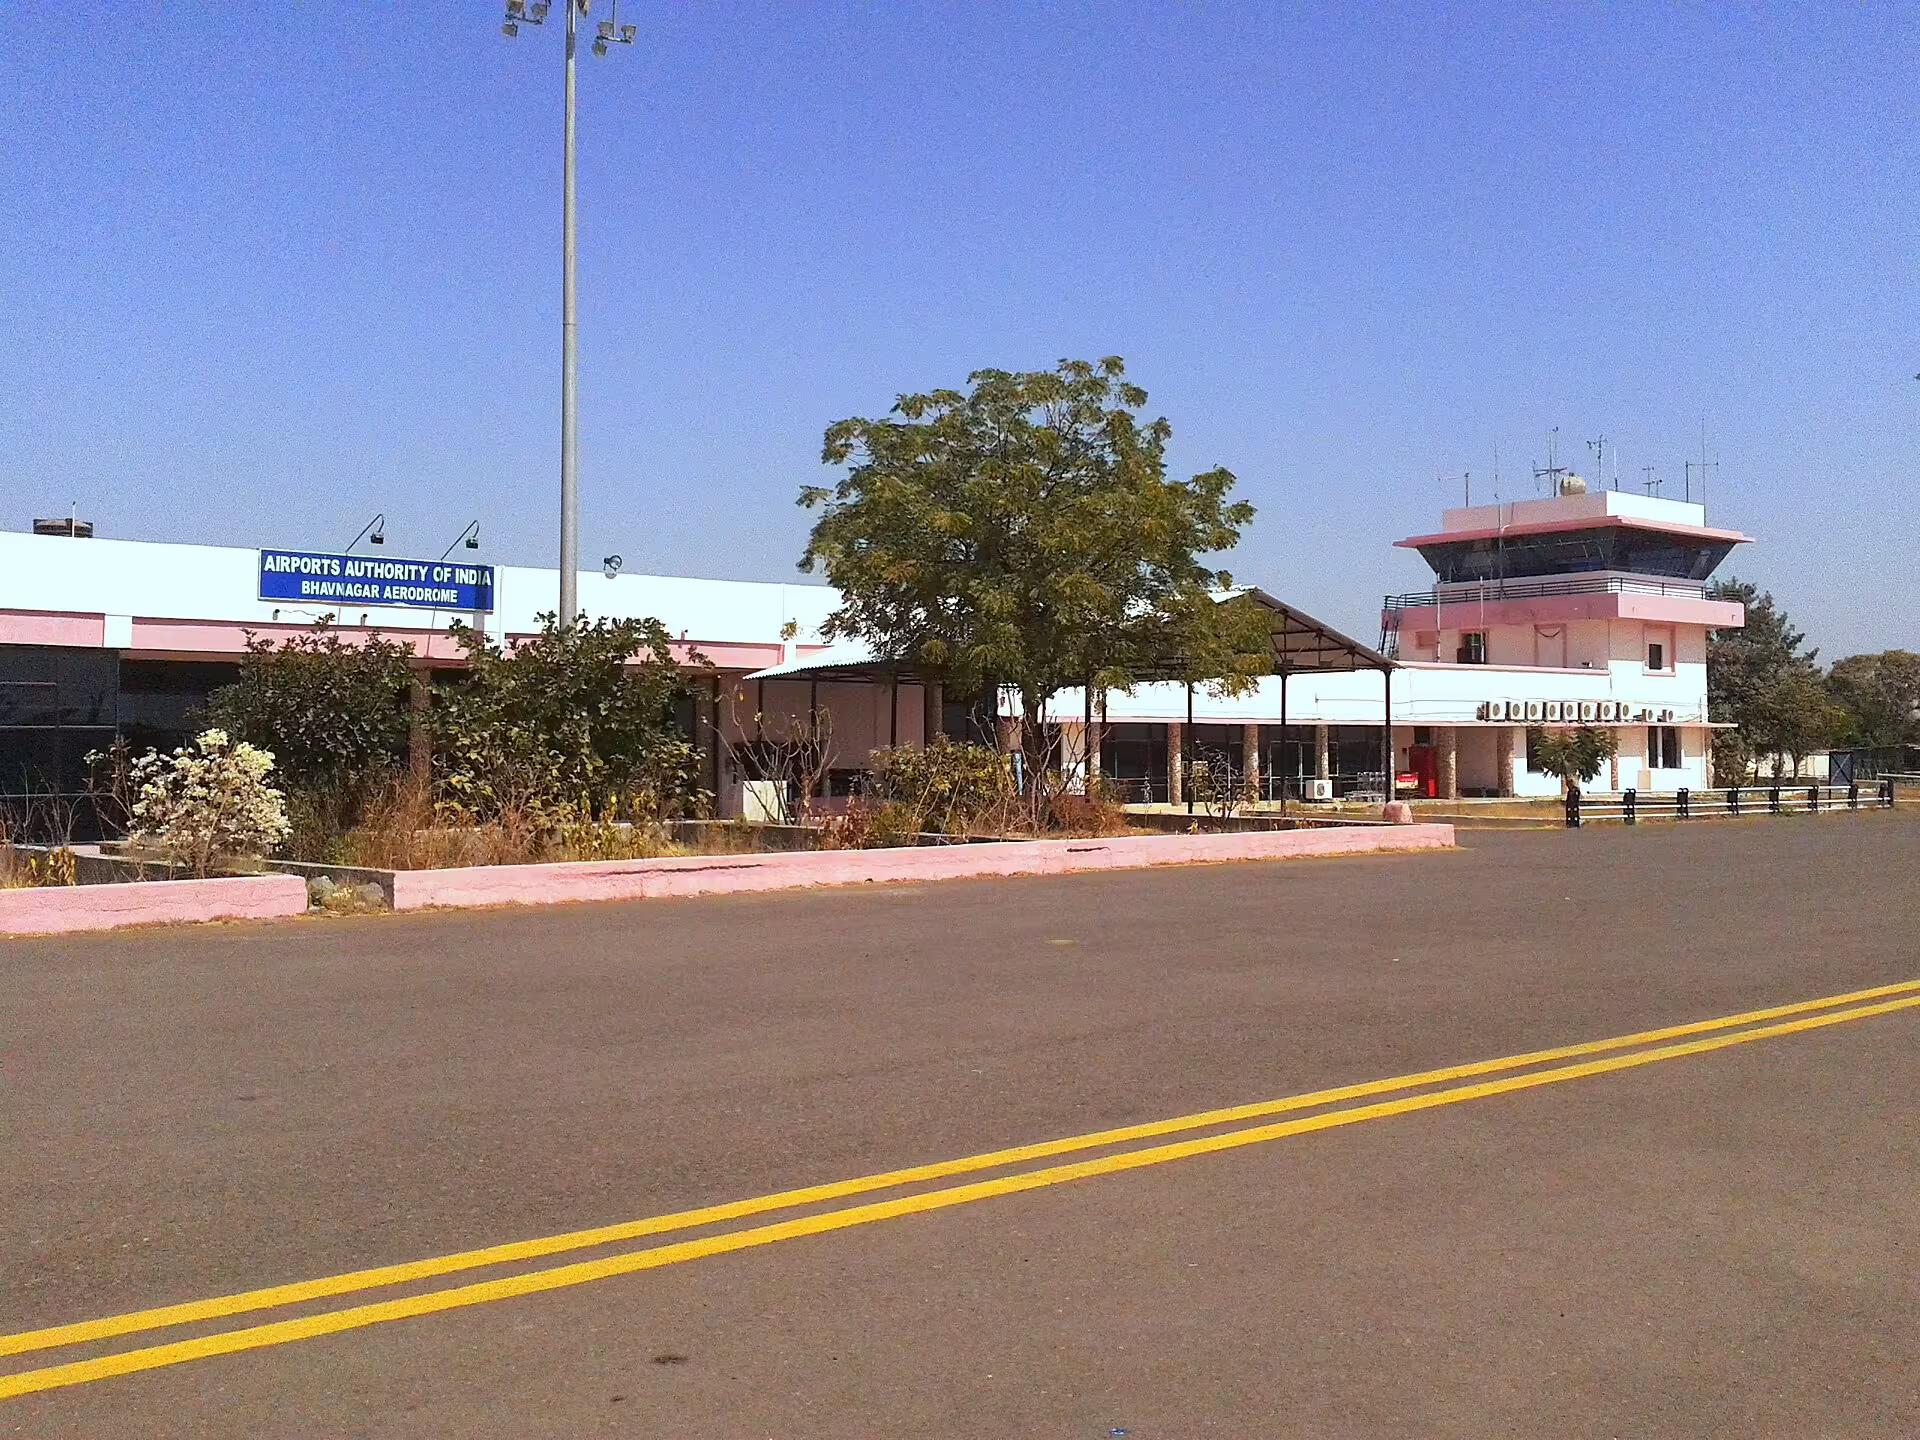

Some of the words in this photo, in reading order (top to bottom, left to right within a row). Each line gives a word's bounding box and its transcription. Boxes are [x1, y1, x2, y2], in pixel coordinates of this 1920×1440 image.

[264, 555, 340, 576] AIRPORTS
[344, 560, 428, 582] AUTHORITY
[433, 566, 452, 583] OF
[455, 568, 491, 586] INDIA
[301, 581, 380, 598] BHAVNAGAR
[383, 585, 458, 603] AERODROME
